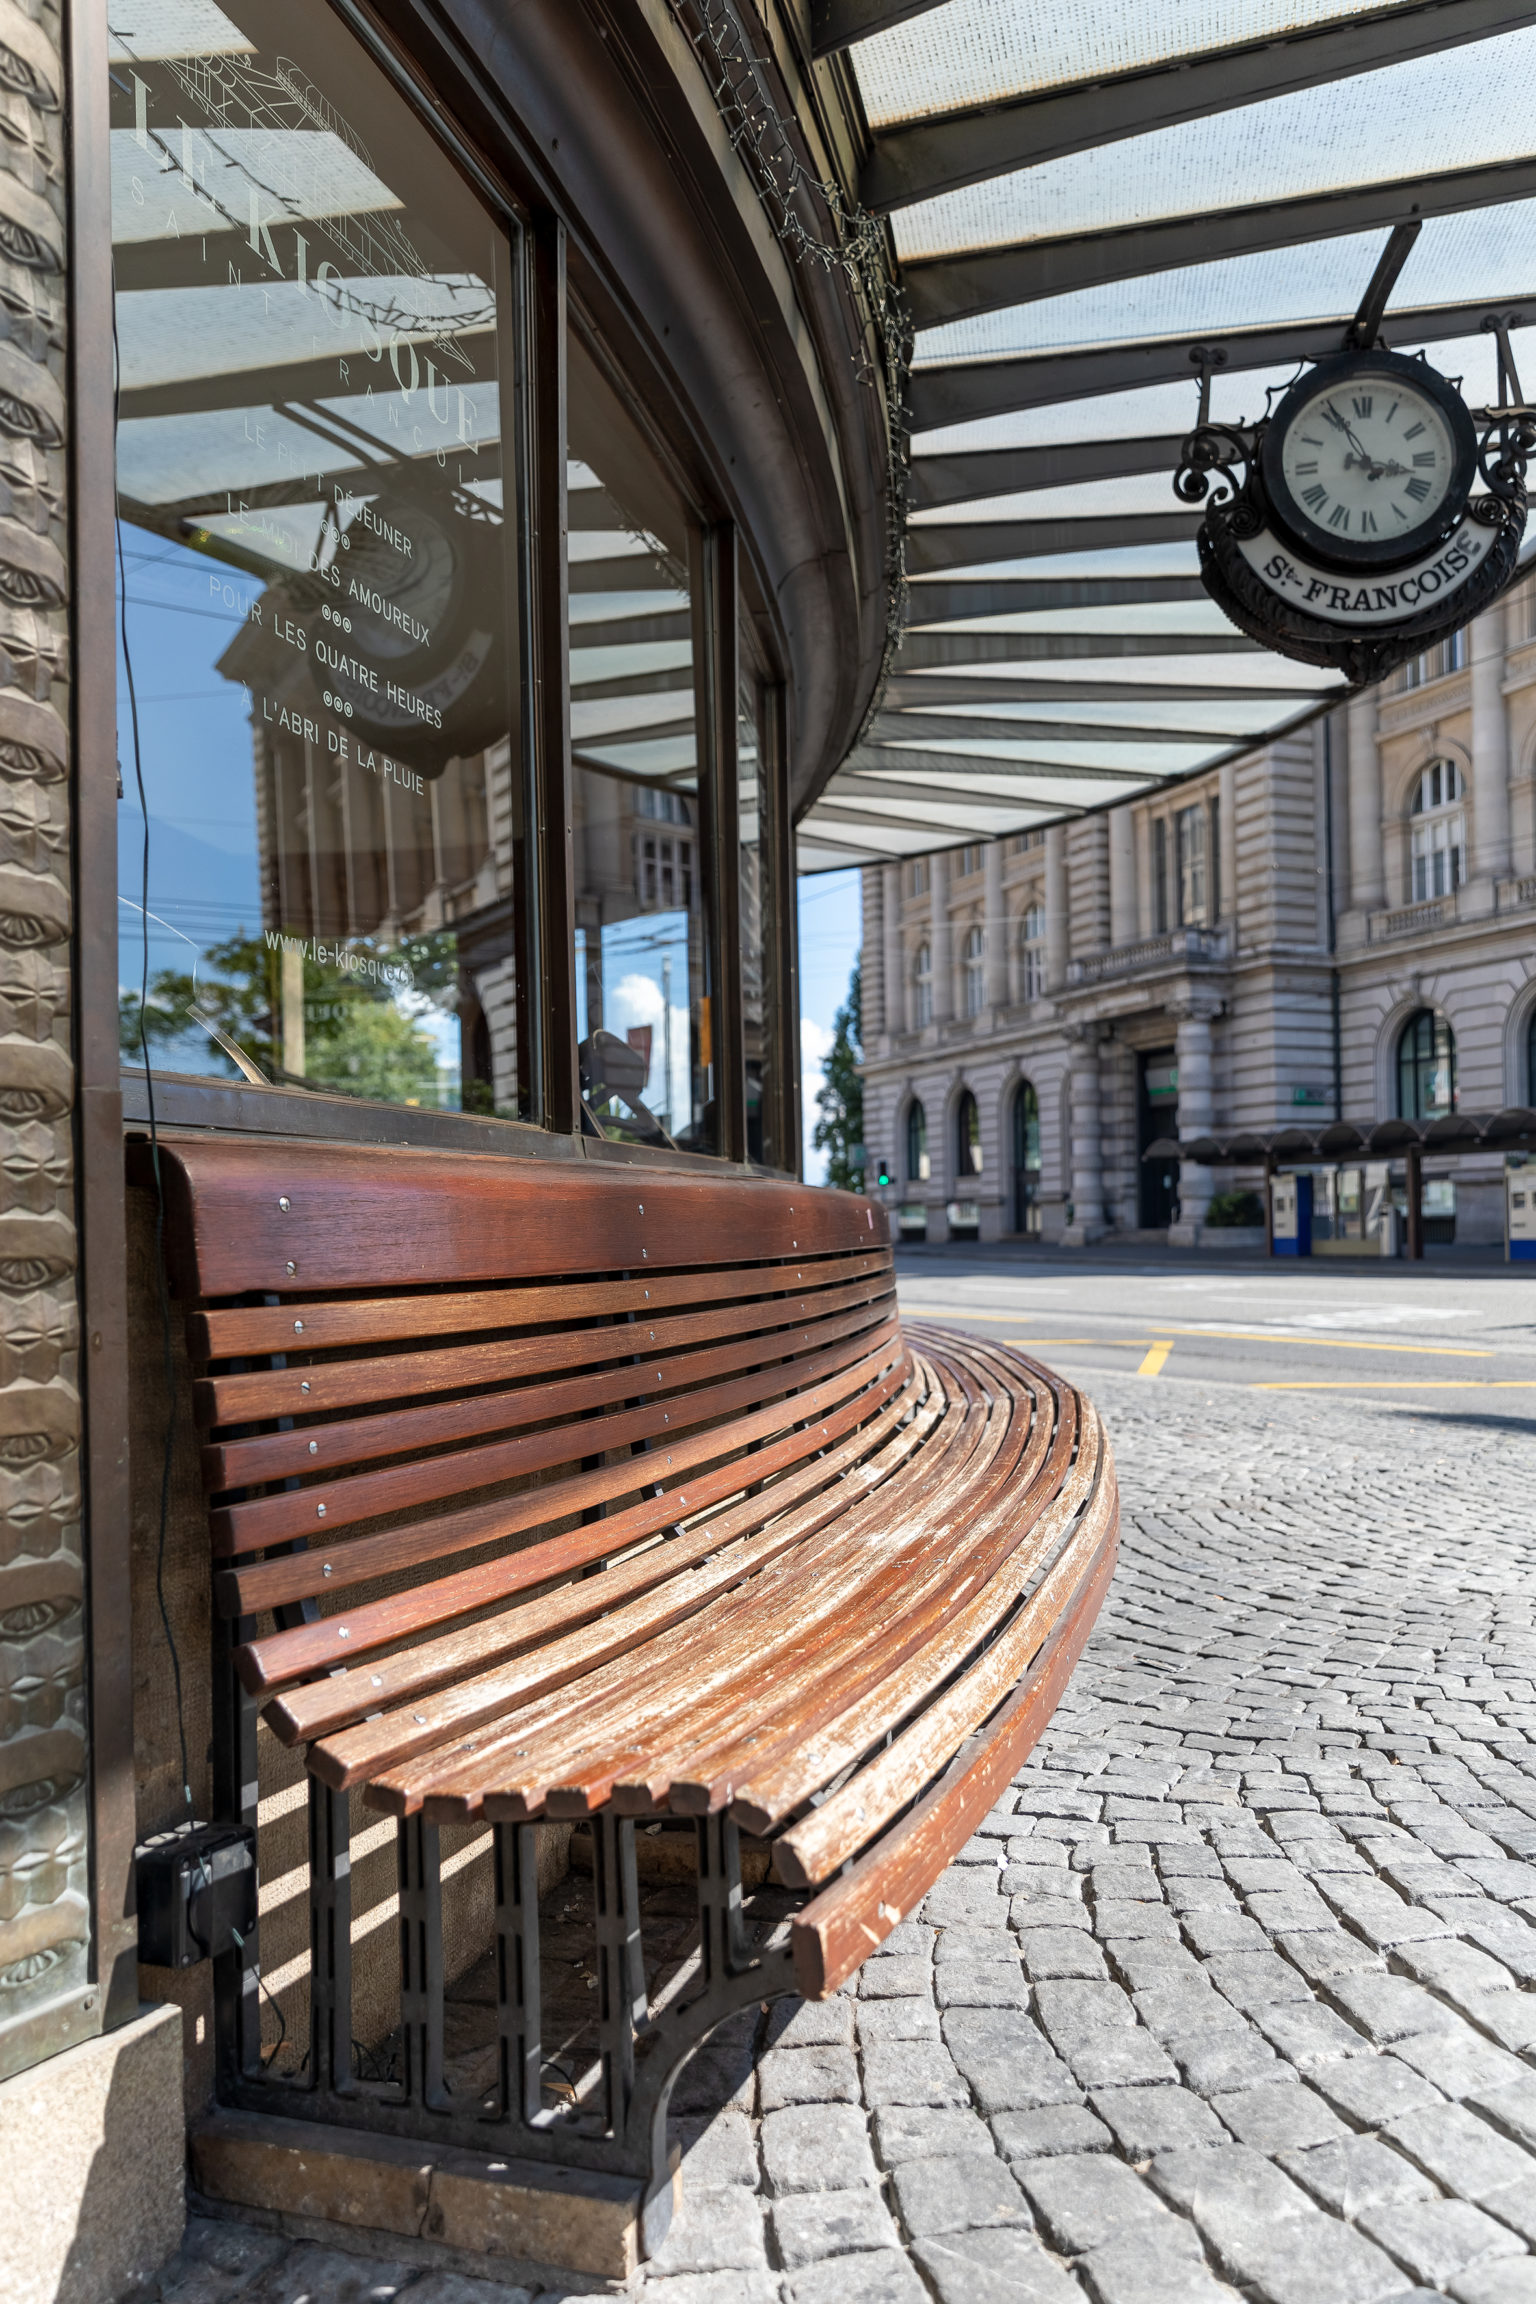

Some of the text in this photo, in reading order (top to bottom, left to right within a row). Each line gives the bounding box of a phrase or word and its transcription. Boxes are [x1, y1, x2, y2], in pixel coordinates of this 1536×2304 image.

[245, 181, 479, 455] KIOSQUE
[244, 415, 413, 560] LE PETIT DÉJEUNER
[228, 492, 250, 527] LE
[309, 551, 341, 588] DES
[348, 578, 430, 648] AMOUREUX
[209, 575, 262, 626] POUR
[275, 613, 307, 651] LES
[315, 639, 379, 694] QUATRE
[386, 680, 442, 729] HEURES
[263, 697, 319, 745] L'ABRI
[328, 729, 349, 760] DE
[357, 745, 377, 774] LA
[383, 757, 425, 796] PLUIE
